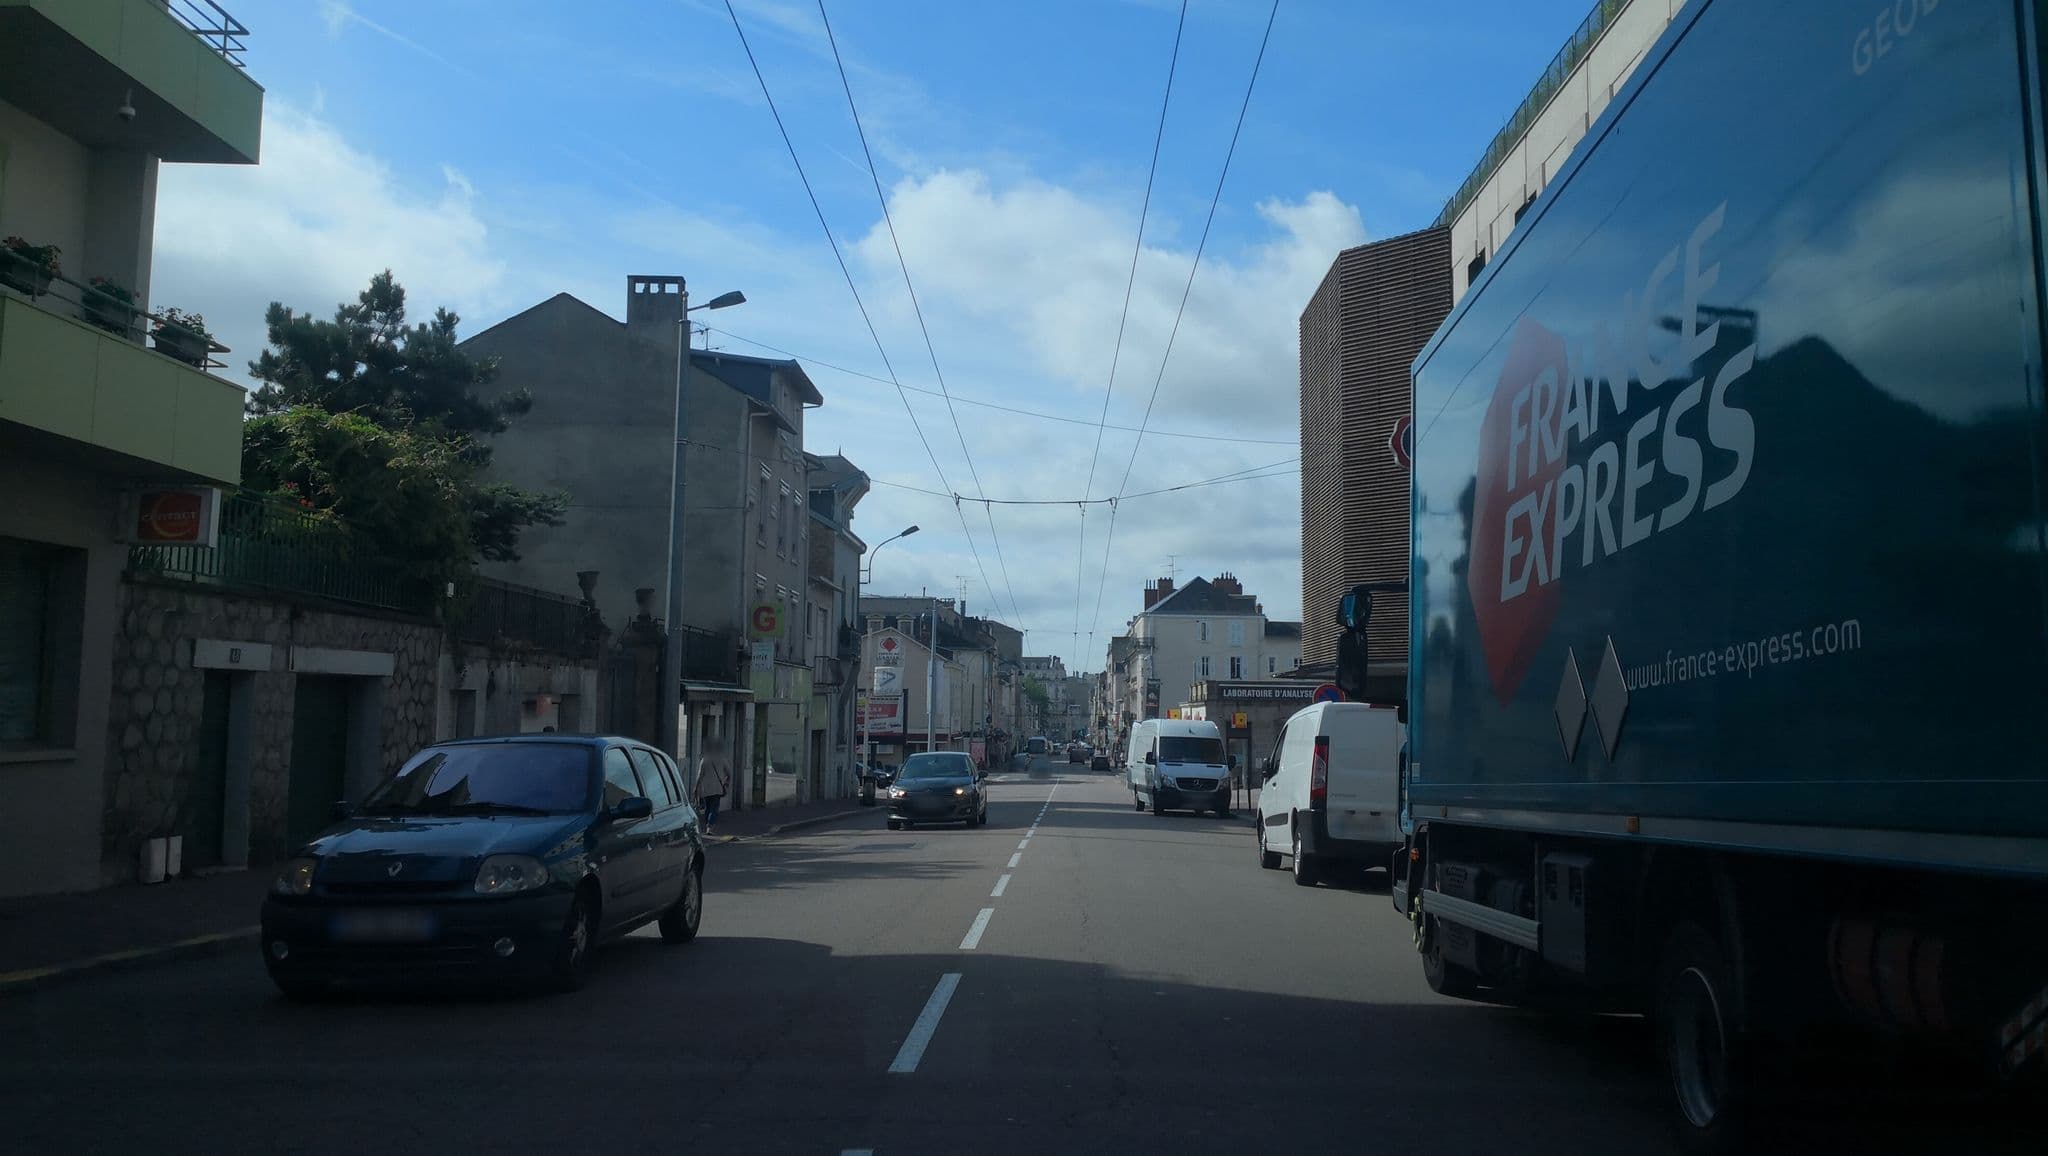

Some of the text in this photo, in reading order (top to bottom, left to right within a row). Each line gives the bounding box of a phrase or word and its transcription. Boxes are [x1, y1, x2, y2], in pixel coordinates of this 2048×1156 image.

[1852, 0, 1939, 76] GEO
[1507, 200, 1728, 493] FRANCE
[1501, 343, 1757, 602] EXPRESS
[1223, 688, 1273, 698] LABORATOIRE
[1627, 618, 1862, 692] www.france-express.com
